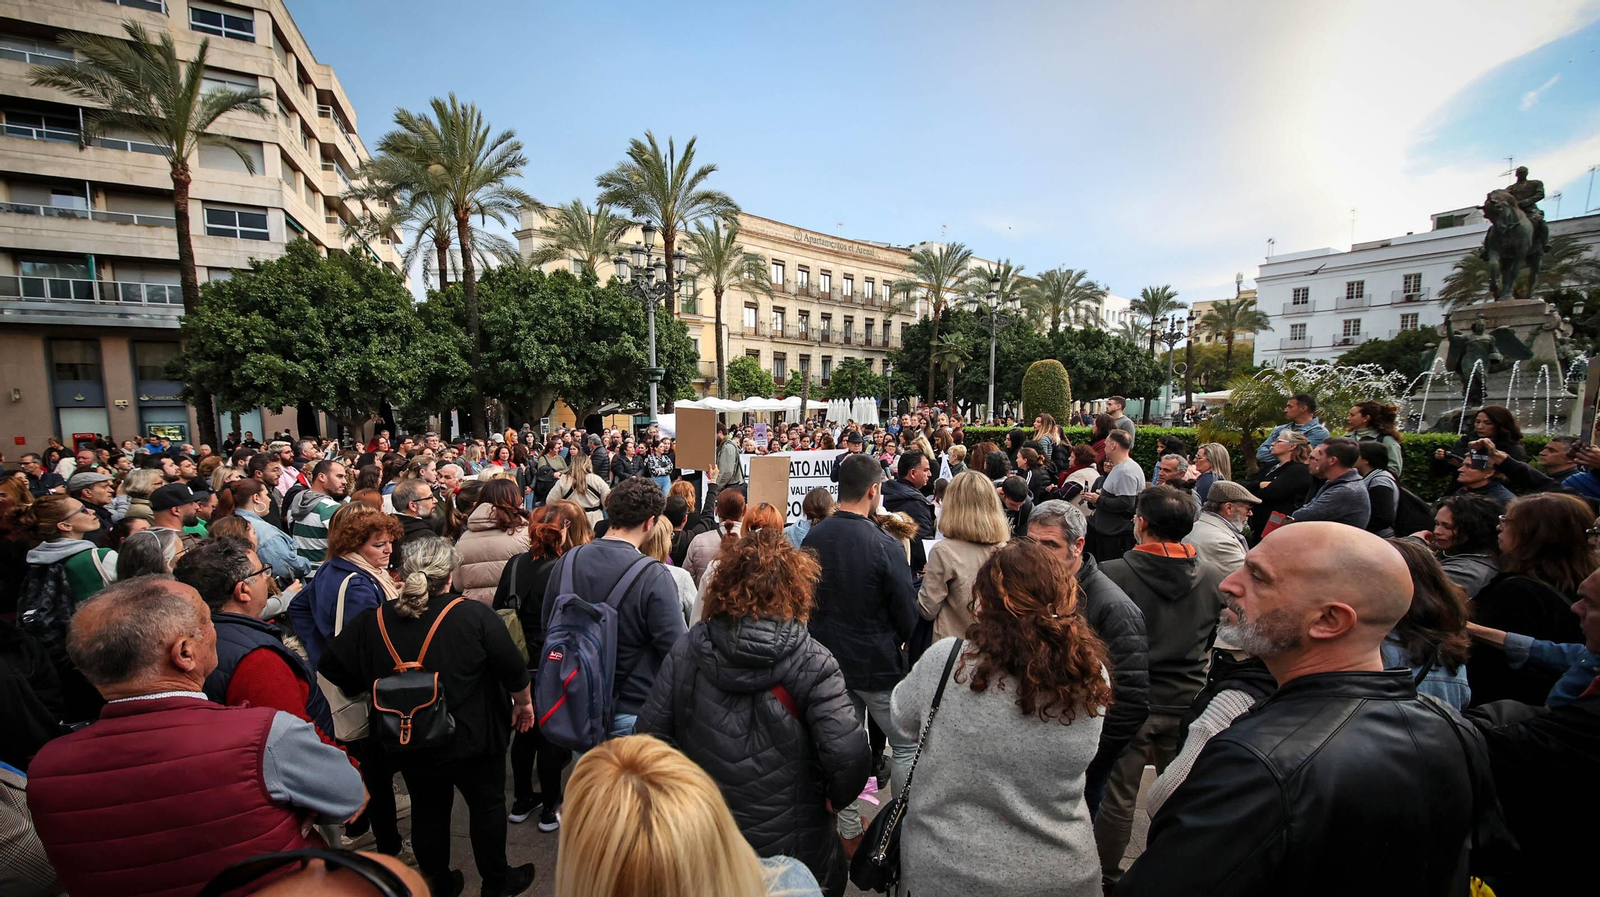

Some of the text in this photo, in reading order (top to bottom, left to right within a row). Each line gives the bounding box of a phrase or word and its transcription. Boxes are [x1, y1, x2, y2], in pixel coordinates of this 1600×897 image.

[803, 233, 875, 256] Apartamentos el Arenal
[790, 460, 811, 476] ATO
[813, 459, 833, 475] ANI
[790, 485, 828, 495] VALIE
